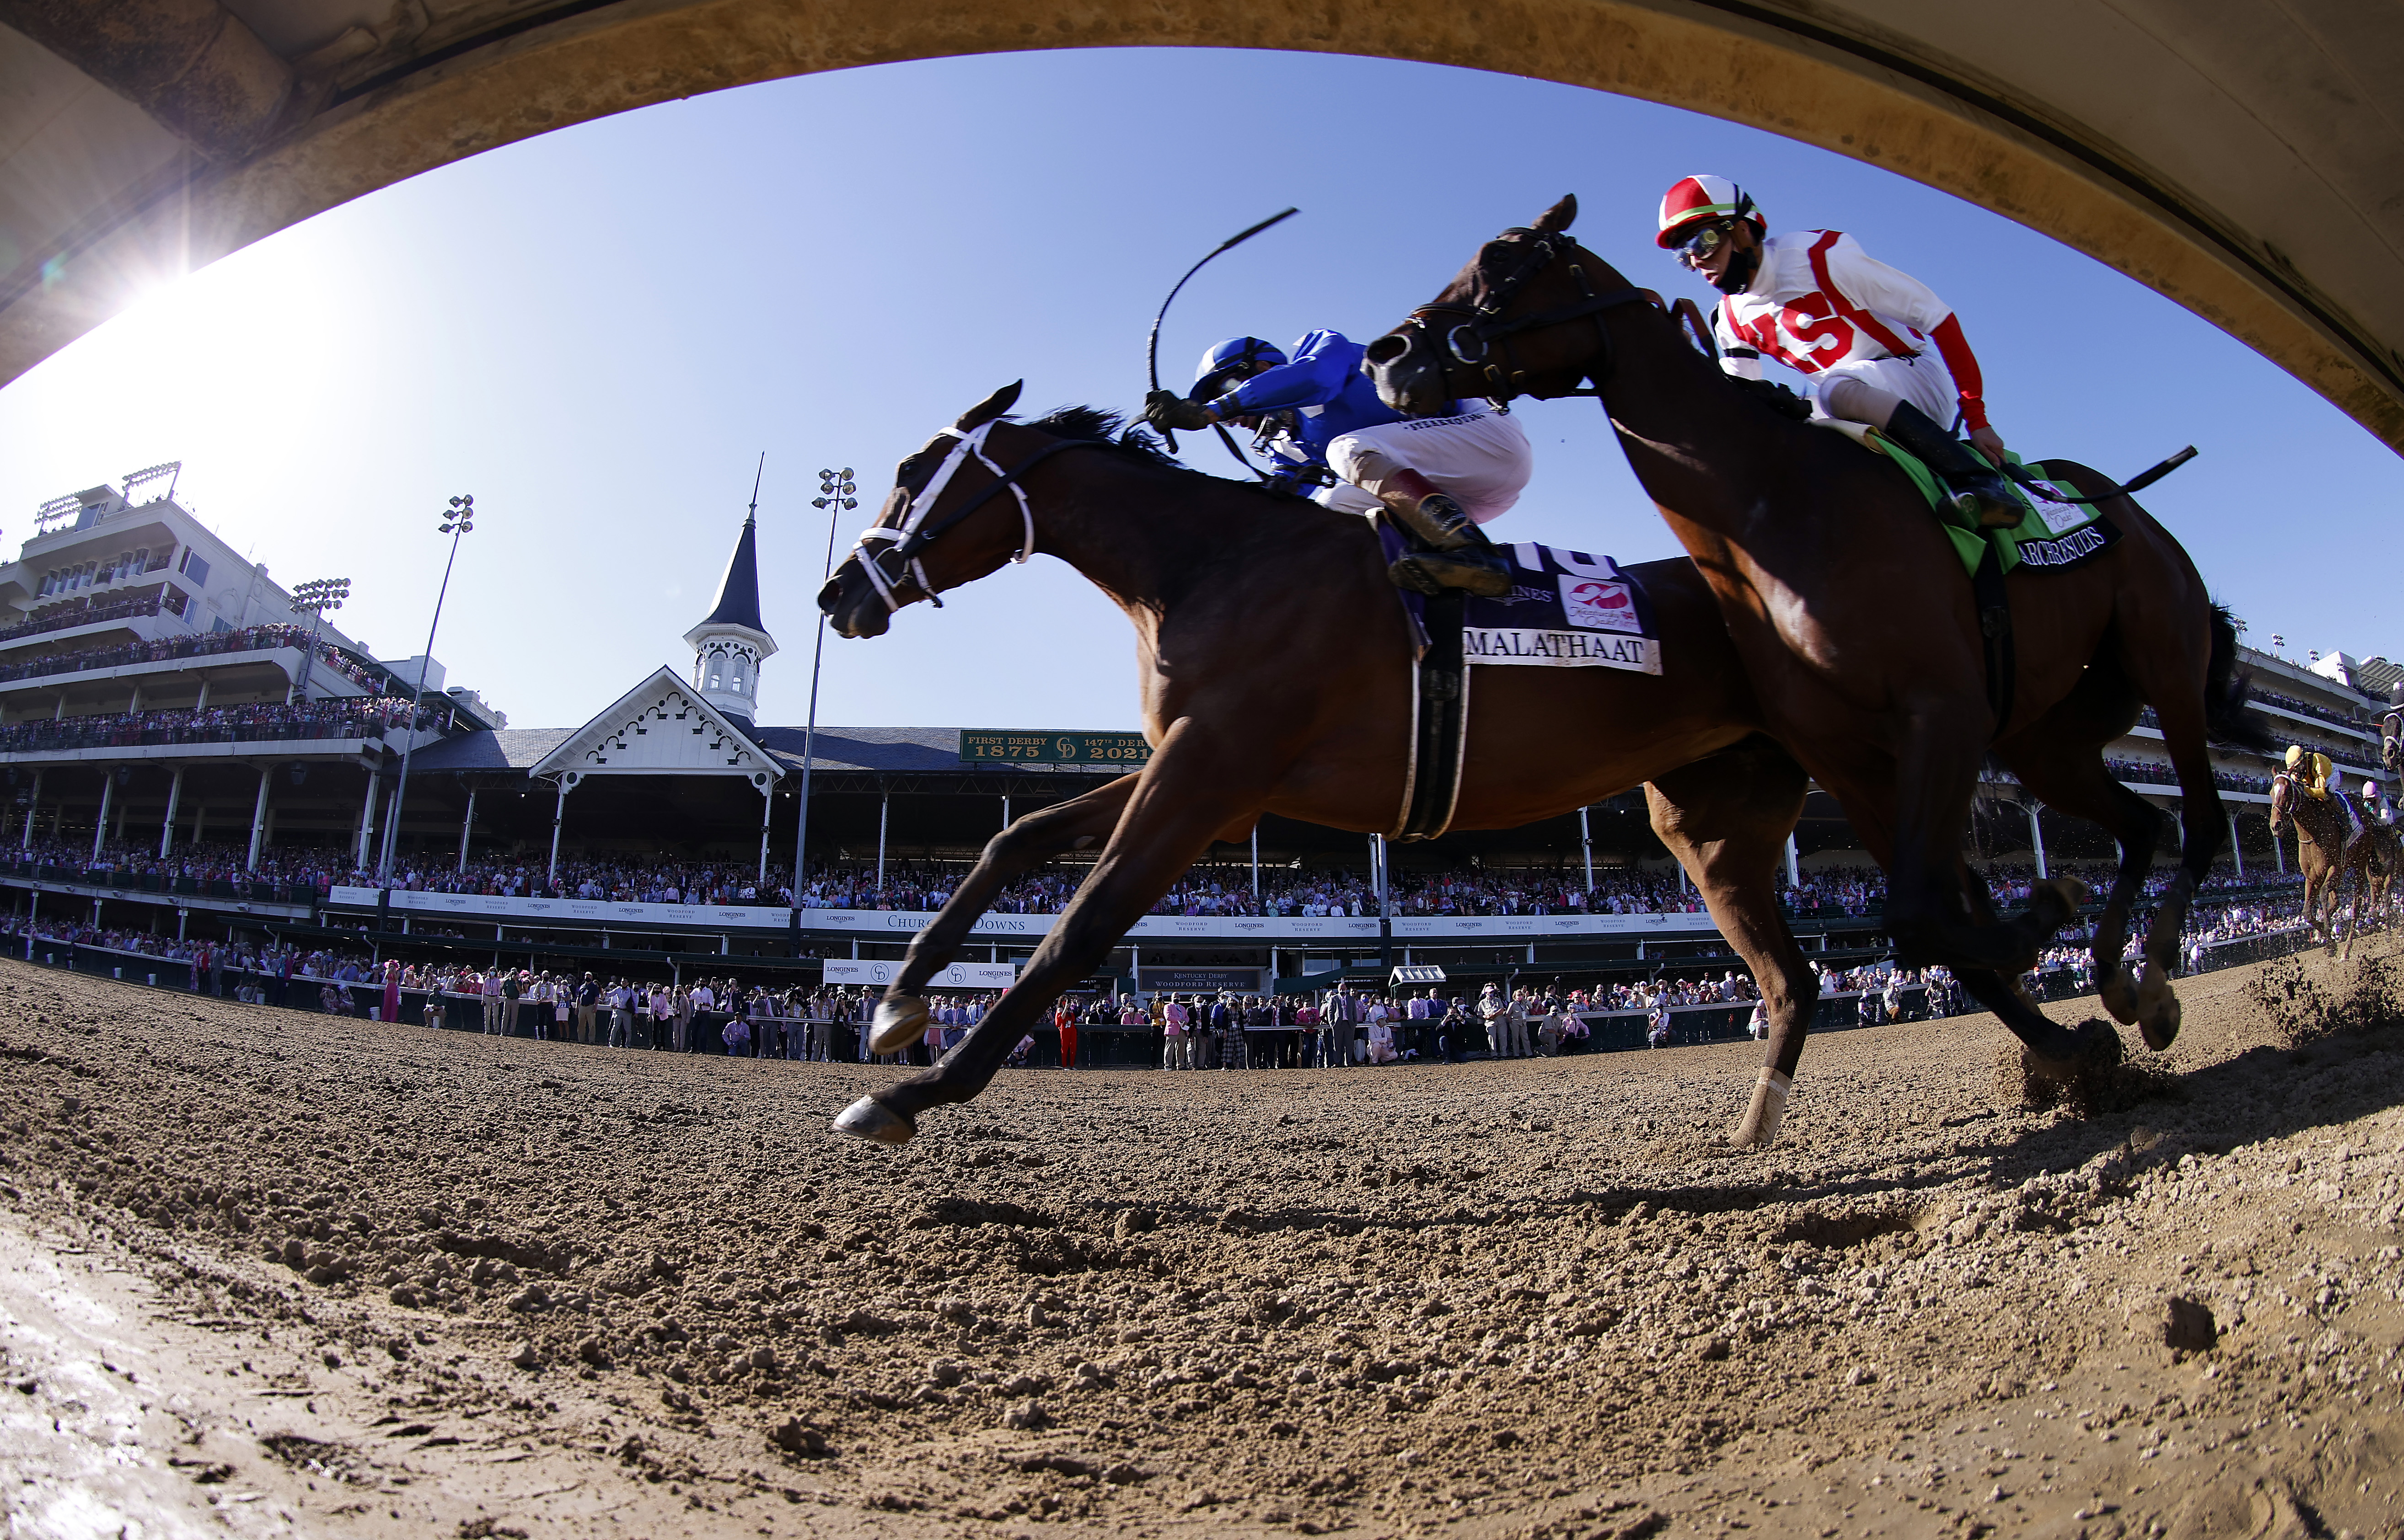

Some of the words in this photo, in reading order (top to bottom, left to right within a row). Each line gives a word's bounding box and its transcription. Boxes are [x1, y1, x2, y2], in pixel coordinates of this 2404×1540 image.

[1463, 631, 1644, 663] MALATHAAT
[976, 746, 1040, 757] 1875
[1090, 748, 1150, 759] 2021
[973, 917, 1025, 930] DOWNS
